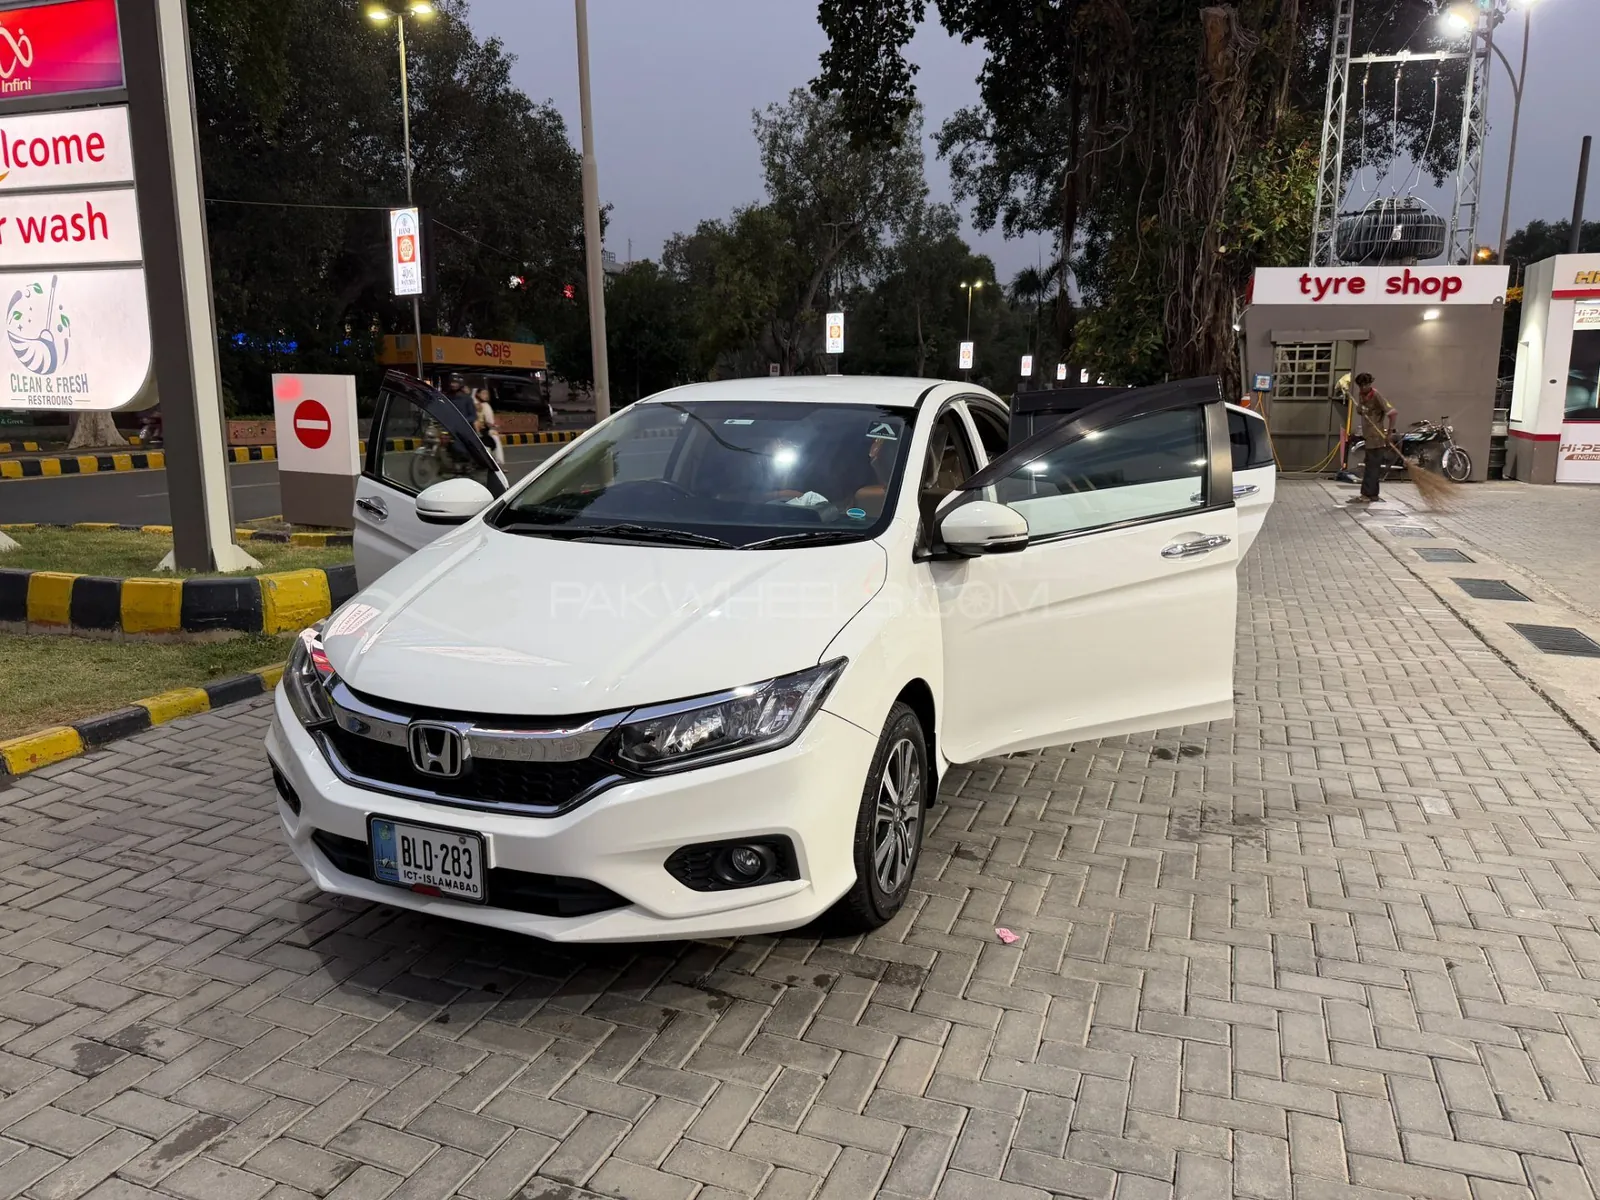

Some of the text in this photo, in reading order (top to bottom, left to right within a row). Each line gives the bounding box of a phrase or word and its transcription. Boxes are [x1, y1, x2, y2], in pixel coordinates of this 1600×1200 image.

[1, 77, 32, 93] Infini
[15, 201, 109, 244] wash
[1299, 268, 1463, 302] tyre shop
[10, 373, 89, 394] CLEAN & FRESH
[27, 395, 73, 406] RESTROOMS
[401, 835, 473, 880] BLD-283
[403, 869, 479, 893] ICT-ISLAMABAD
